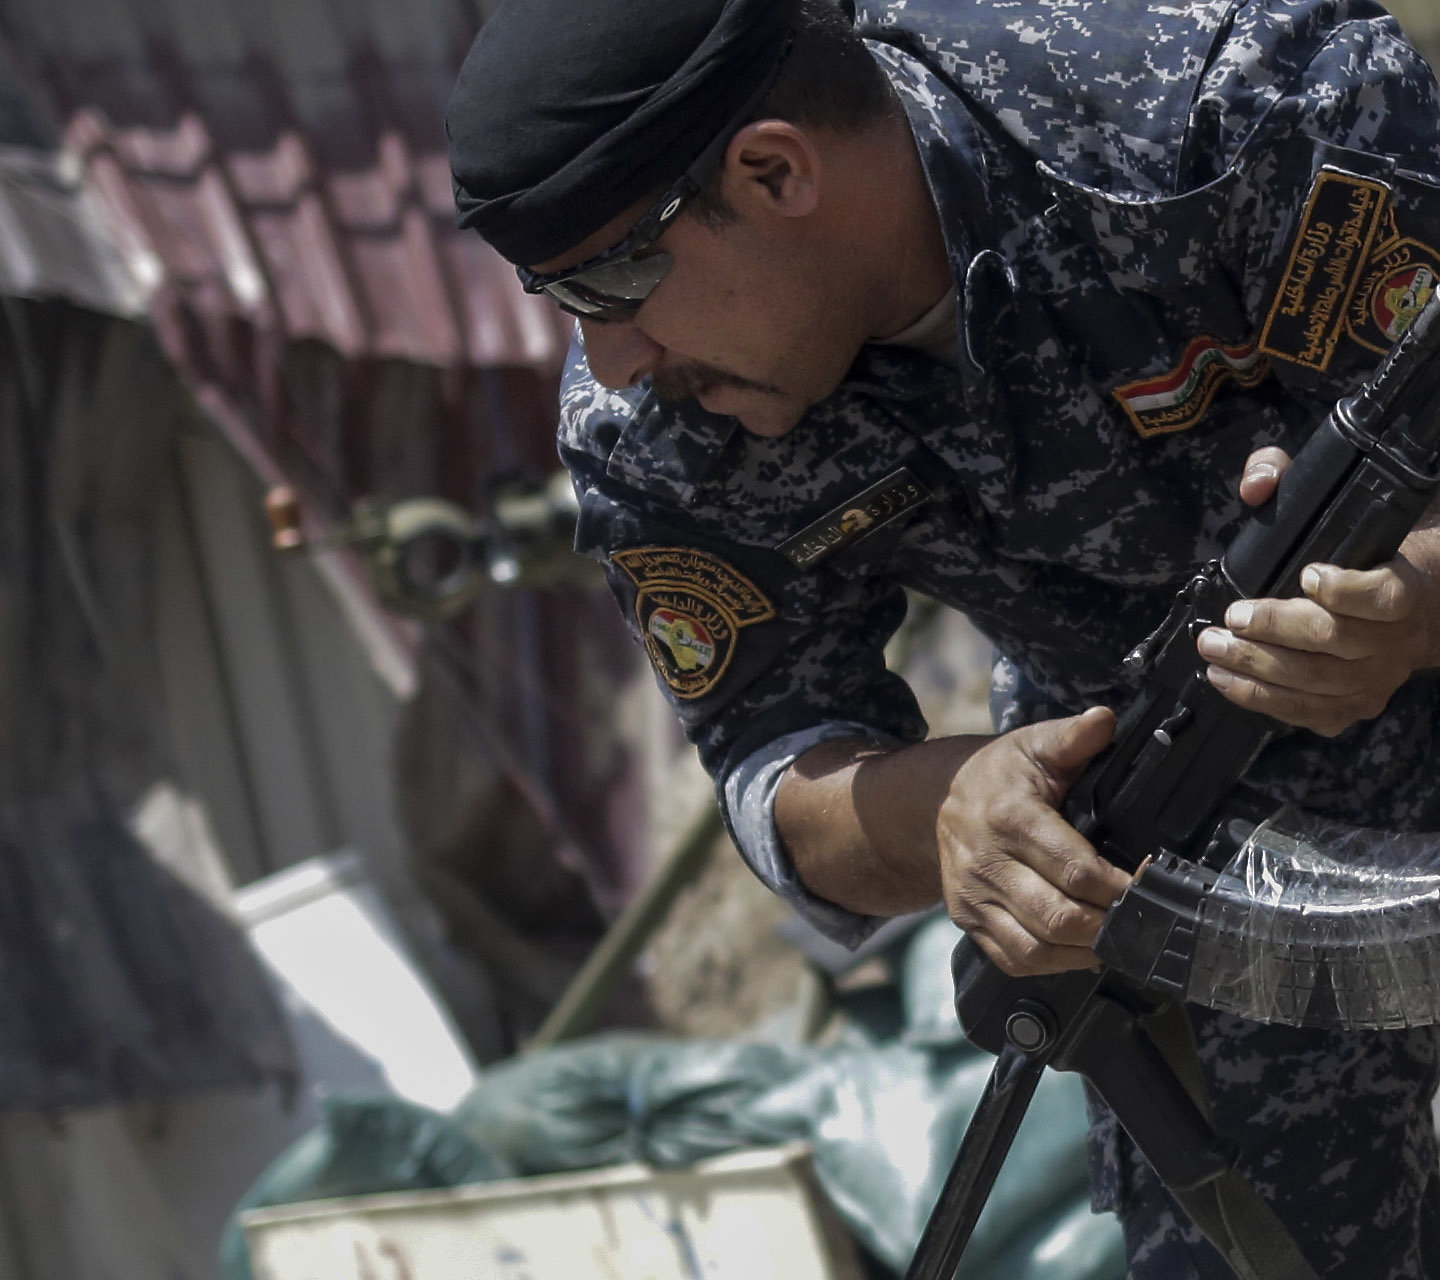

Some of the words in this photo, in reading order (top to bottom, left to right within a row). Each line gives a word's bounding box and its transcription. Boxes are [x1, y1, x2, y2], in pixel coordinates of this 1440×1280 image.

[1347, 186, 1375, 228] قيادة
[1302, 221, 1333, 260] وزارة
[1334, 223, 1363, 259] قوات
[1281, 254, 1317, 318] الداخلية
[1315, 254, 1350, 308] الشرطة
[1298, 305, 1332, 363] الاتحادية
[867, 485, 918, 516] وزارة
[790, 525, 844, 562] الداخلية
